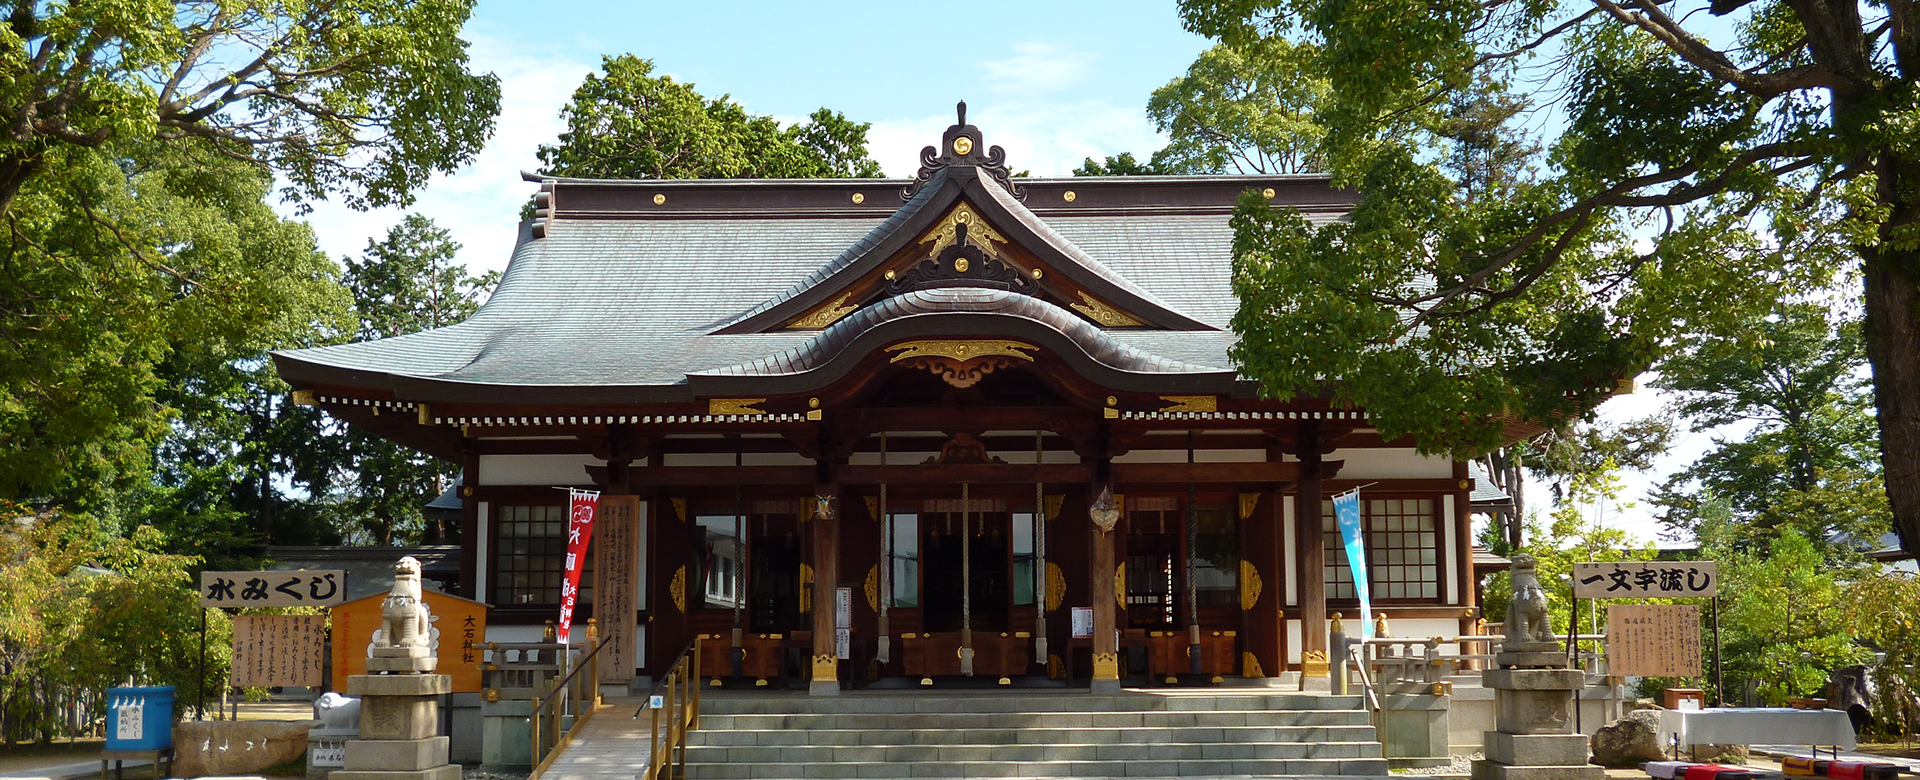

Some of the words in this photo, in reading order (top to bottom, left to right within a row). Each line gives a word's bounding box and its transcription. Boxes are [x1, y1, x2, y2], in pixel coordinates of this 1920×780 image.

[207, 573, 337, 600] 水みくじ
[1580, 568, 1710, 592] 一文字流し
[314, 624, 323, 671] 水みくじ
[462, 615, 476, 664] 大石神社
